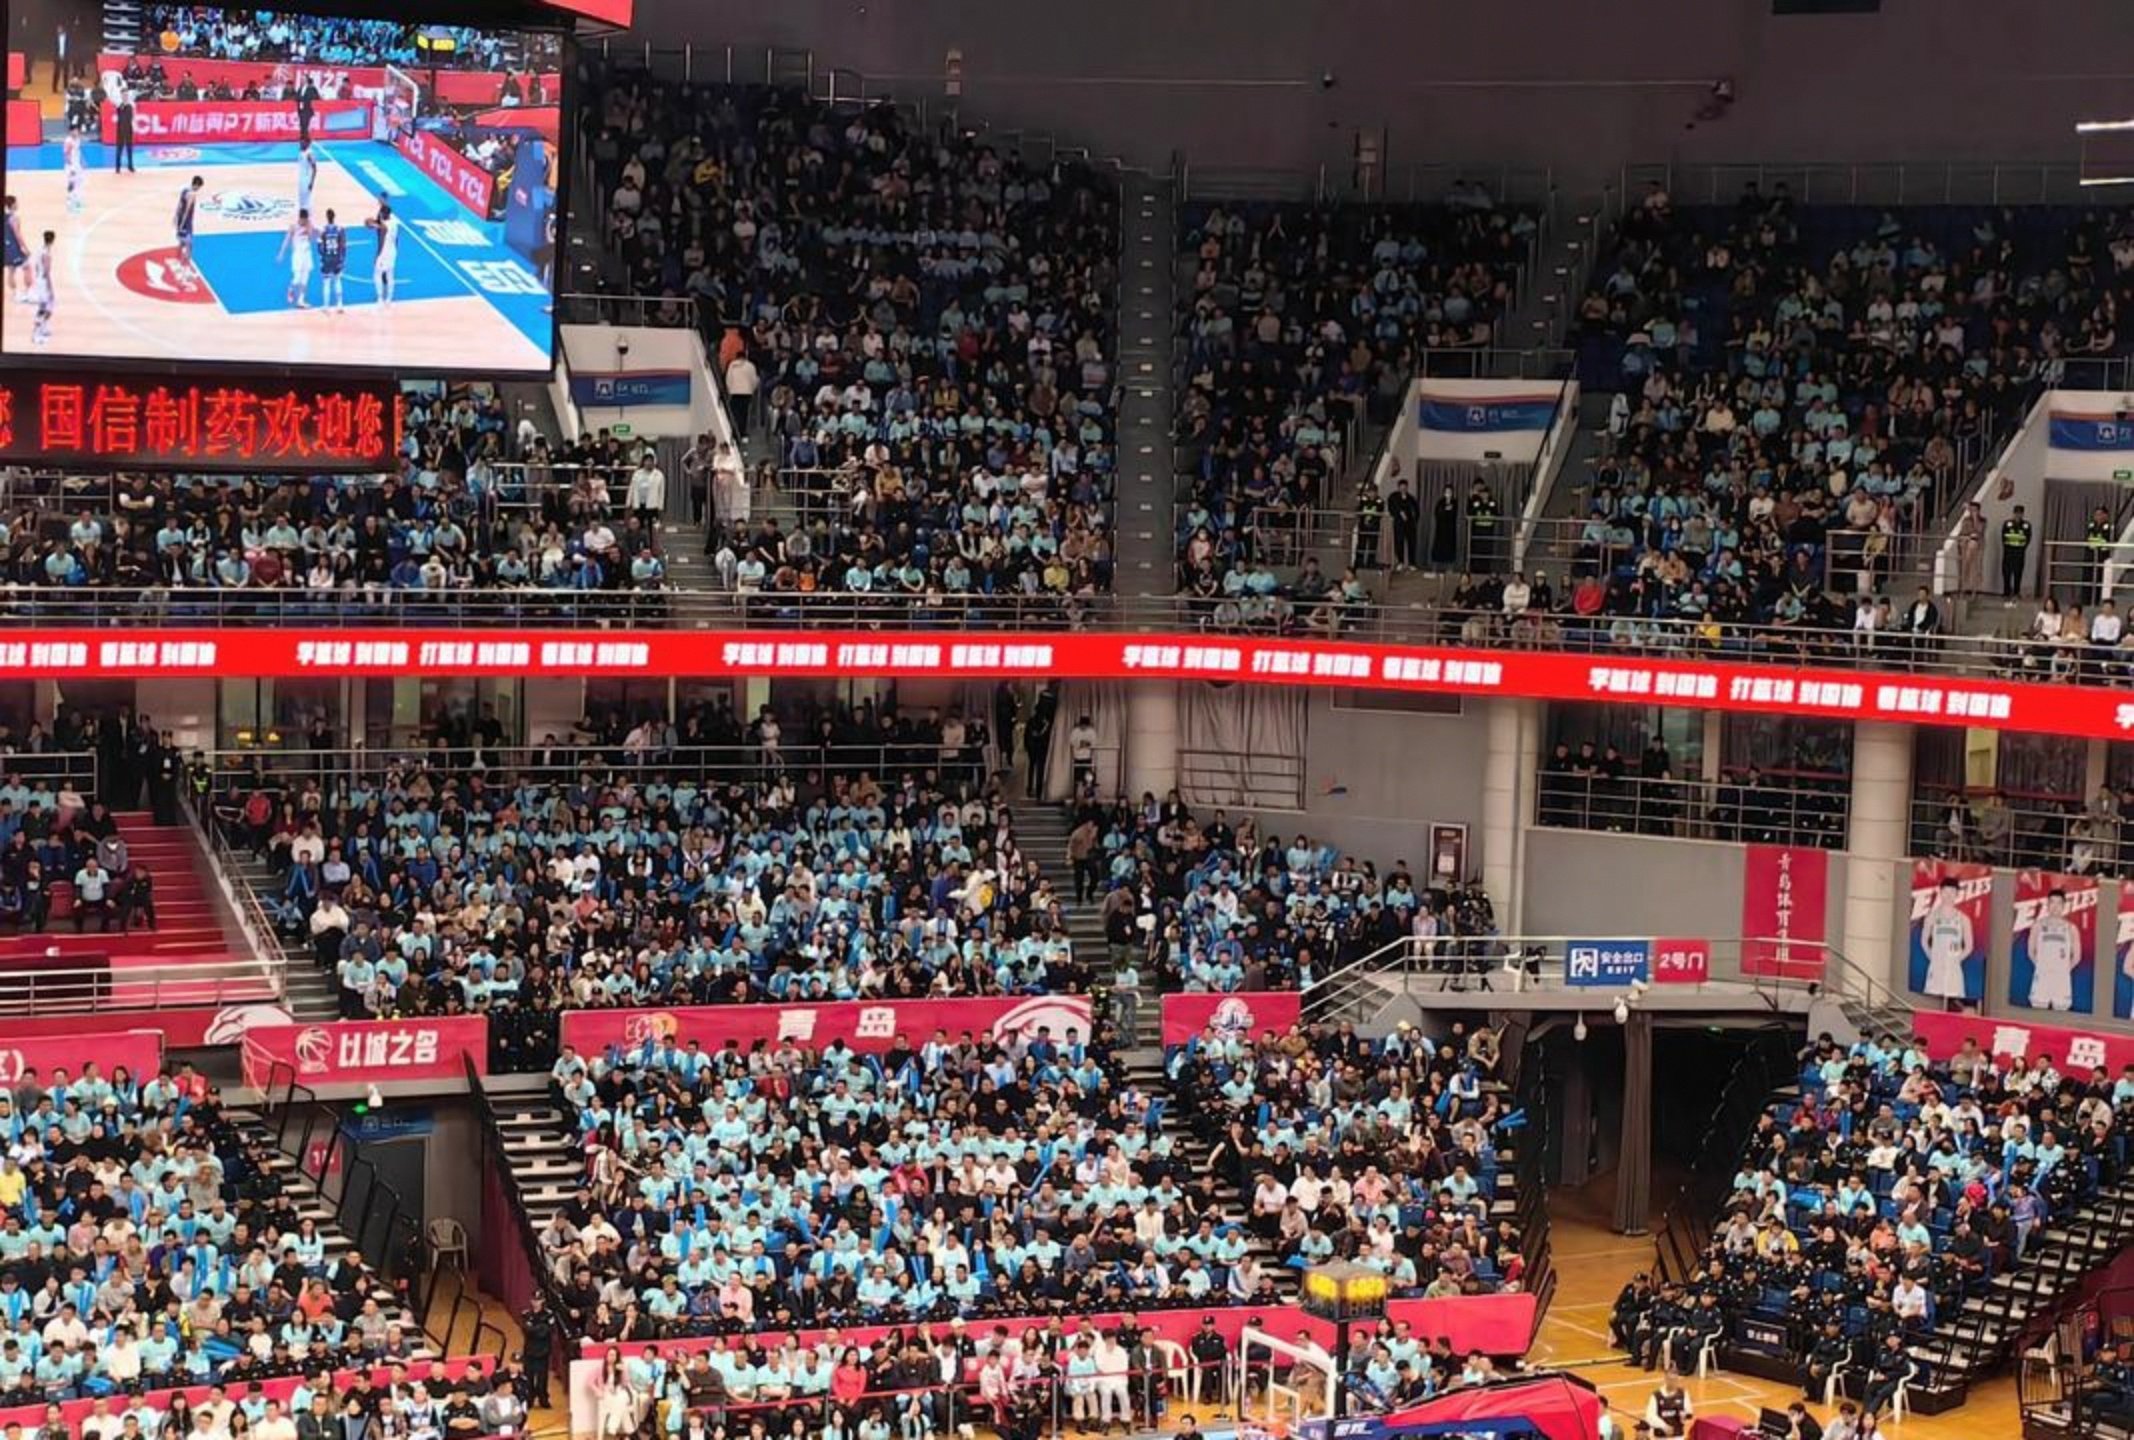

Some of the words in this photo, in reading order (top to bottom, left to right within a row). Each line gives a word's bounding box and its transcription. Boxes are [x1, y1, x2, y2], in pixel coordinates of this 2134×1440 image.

[112, 113, 168, 135] CL
[430, 147, 453, 183] TCL
[459, 167, 486, 208] TCL
[41, 383, 384, 459] 国信制药欢迎您
[1601, 951, 1644, 965] 安全出口
[1659, 951, 1704, 970] 2号门
[338, 1030, 439, 1068] 以城之名
